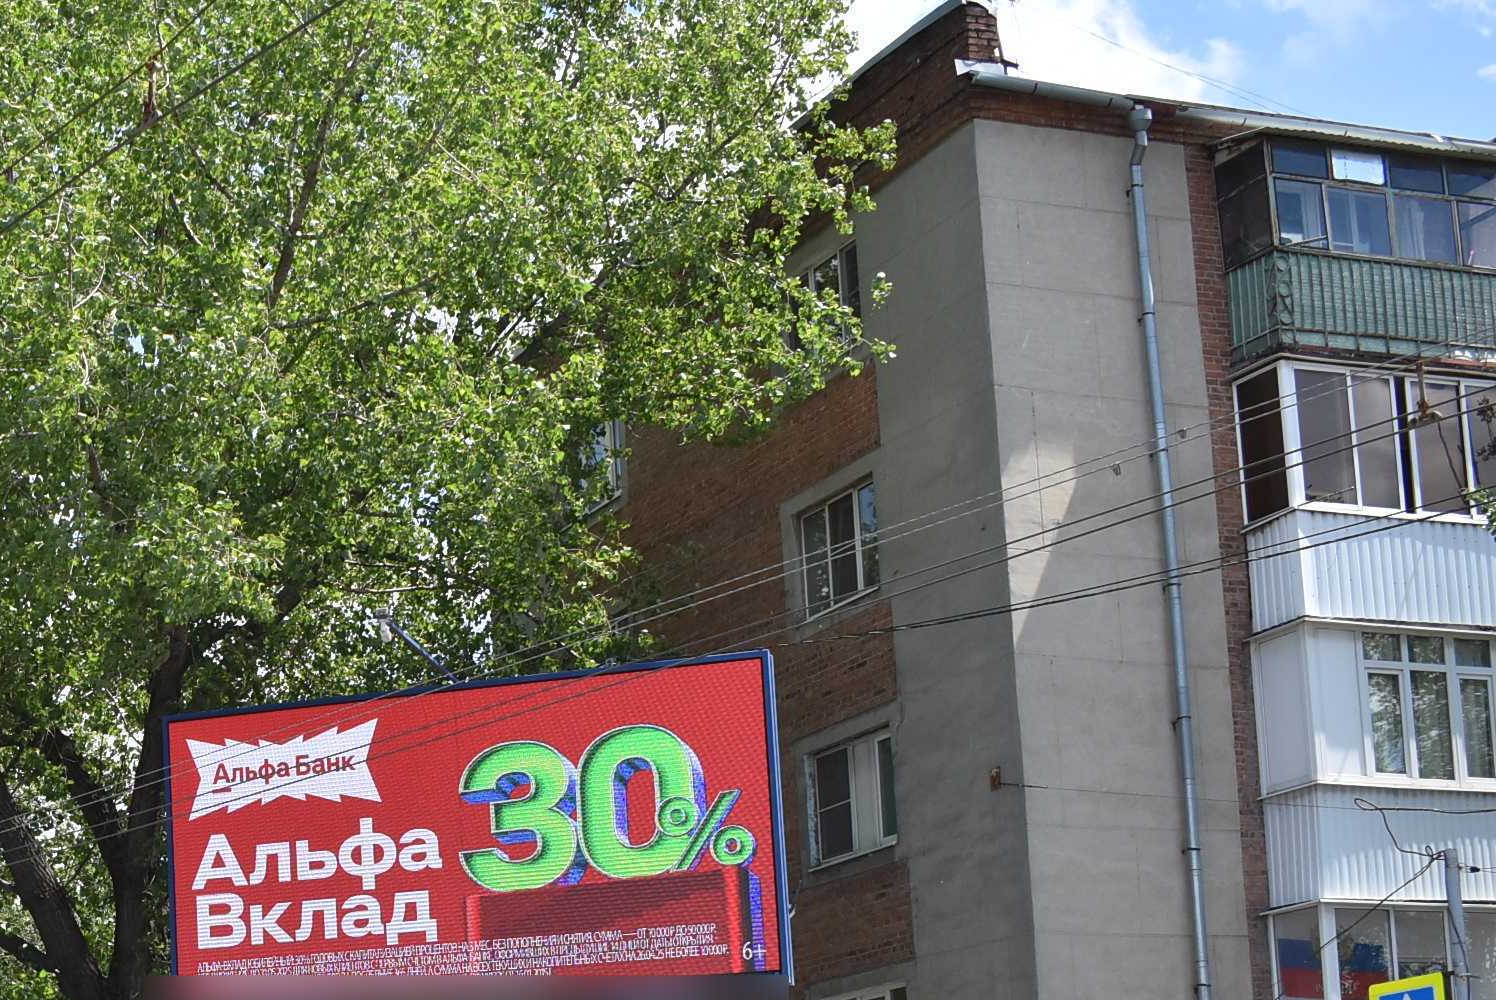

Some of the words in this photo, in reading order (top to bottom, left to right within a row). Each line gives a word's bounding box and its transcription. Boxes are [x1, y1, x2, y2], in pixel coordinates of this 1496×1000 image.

[212, 759, 290, 785] Альфа
[295, 754, 356, 776] Банк
[458, 723, 756, 893] 30%
[191, 817, 443, 890] Альфа
[196, 890, 438, 950] Вклад
[743, 941, 767, 960] 6+
